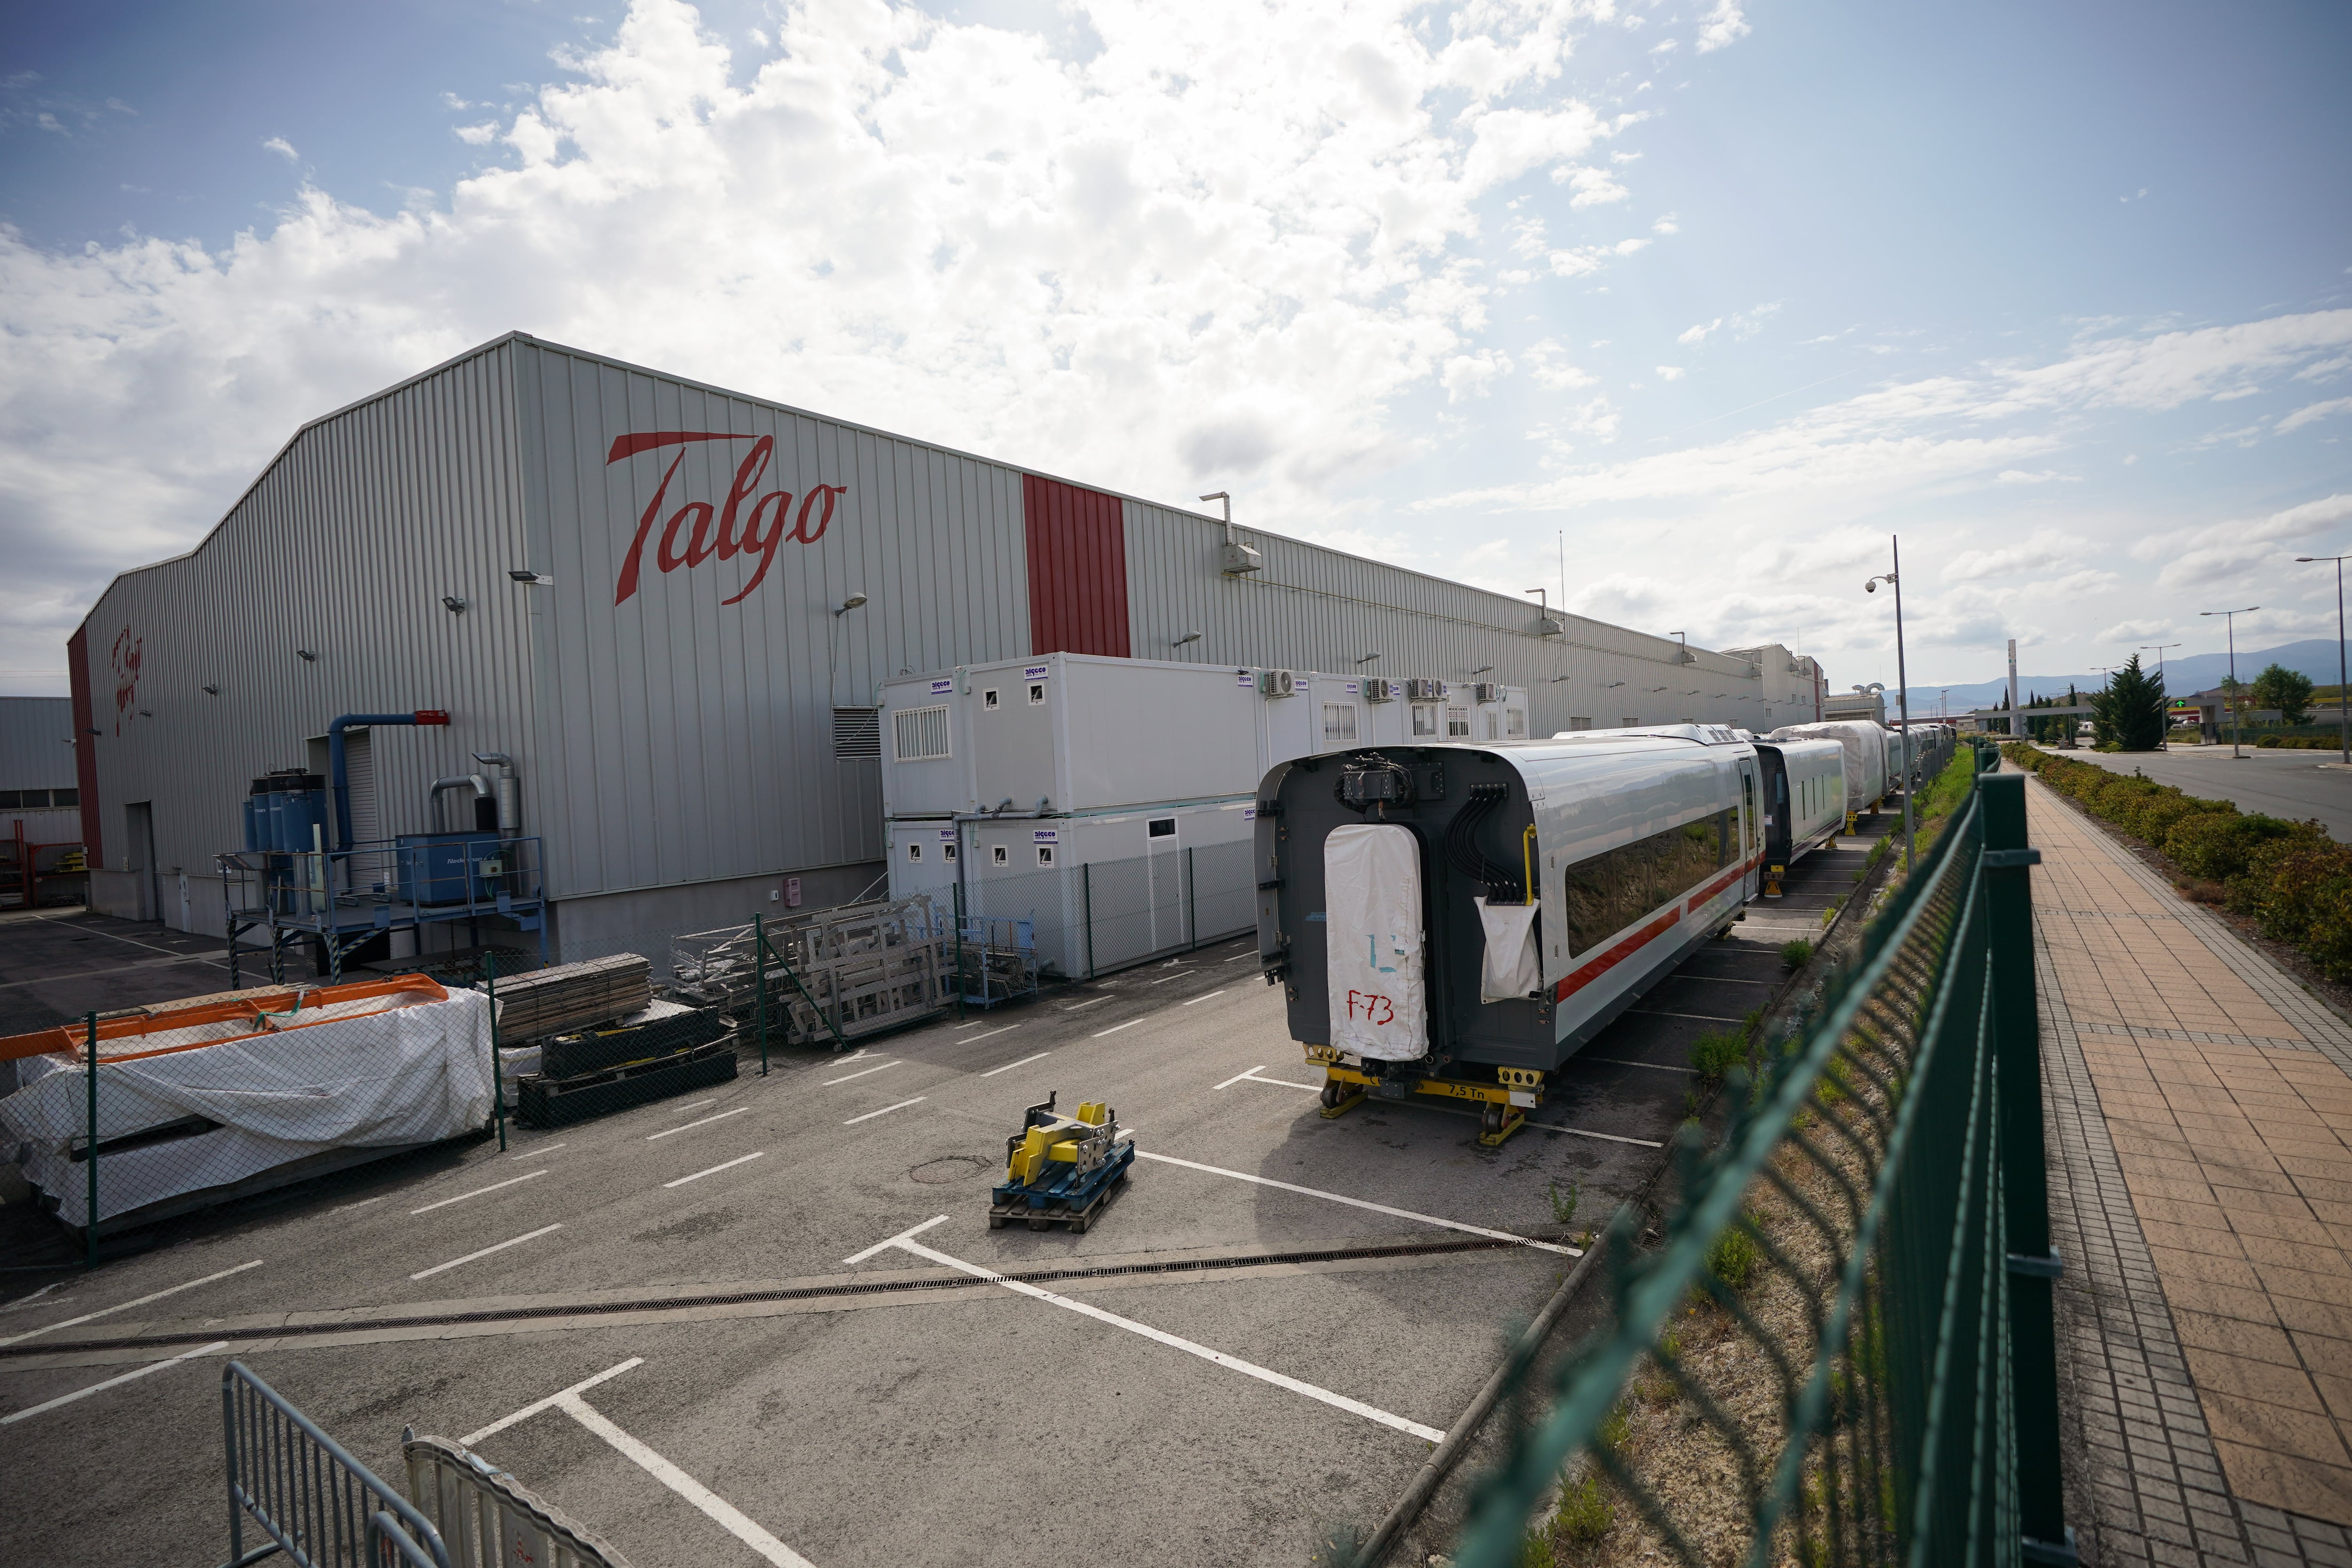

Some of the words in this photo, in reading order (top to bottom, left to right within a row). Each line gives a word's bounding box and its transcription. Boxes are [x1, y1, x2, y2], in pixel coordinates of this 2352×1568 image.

[606, 431, 847, 607] Talgo
[1449, 1085, 1466, 1096] 7,5
[1470, 1088, 1484, 1099] Tn
